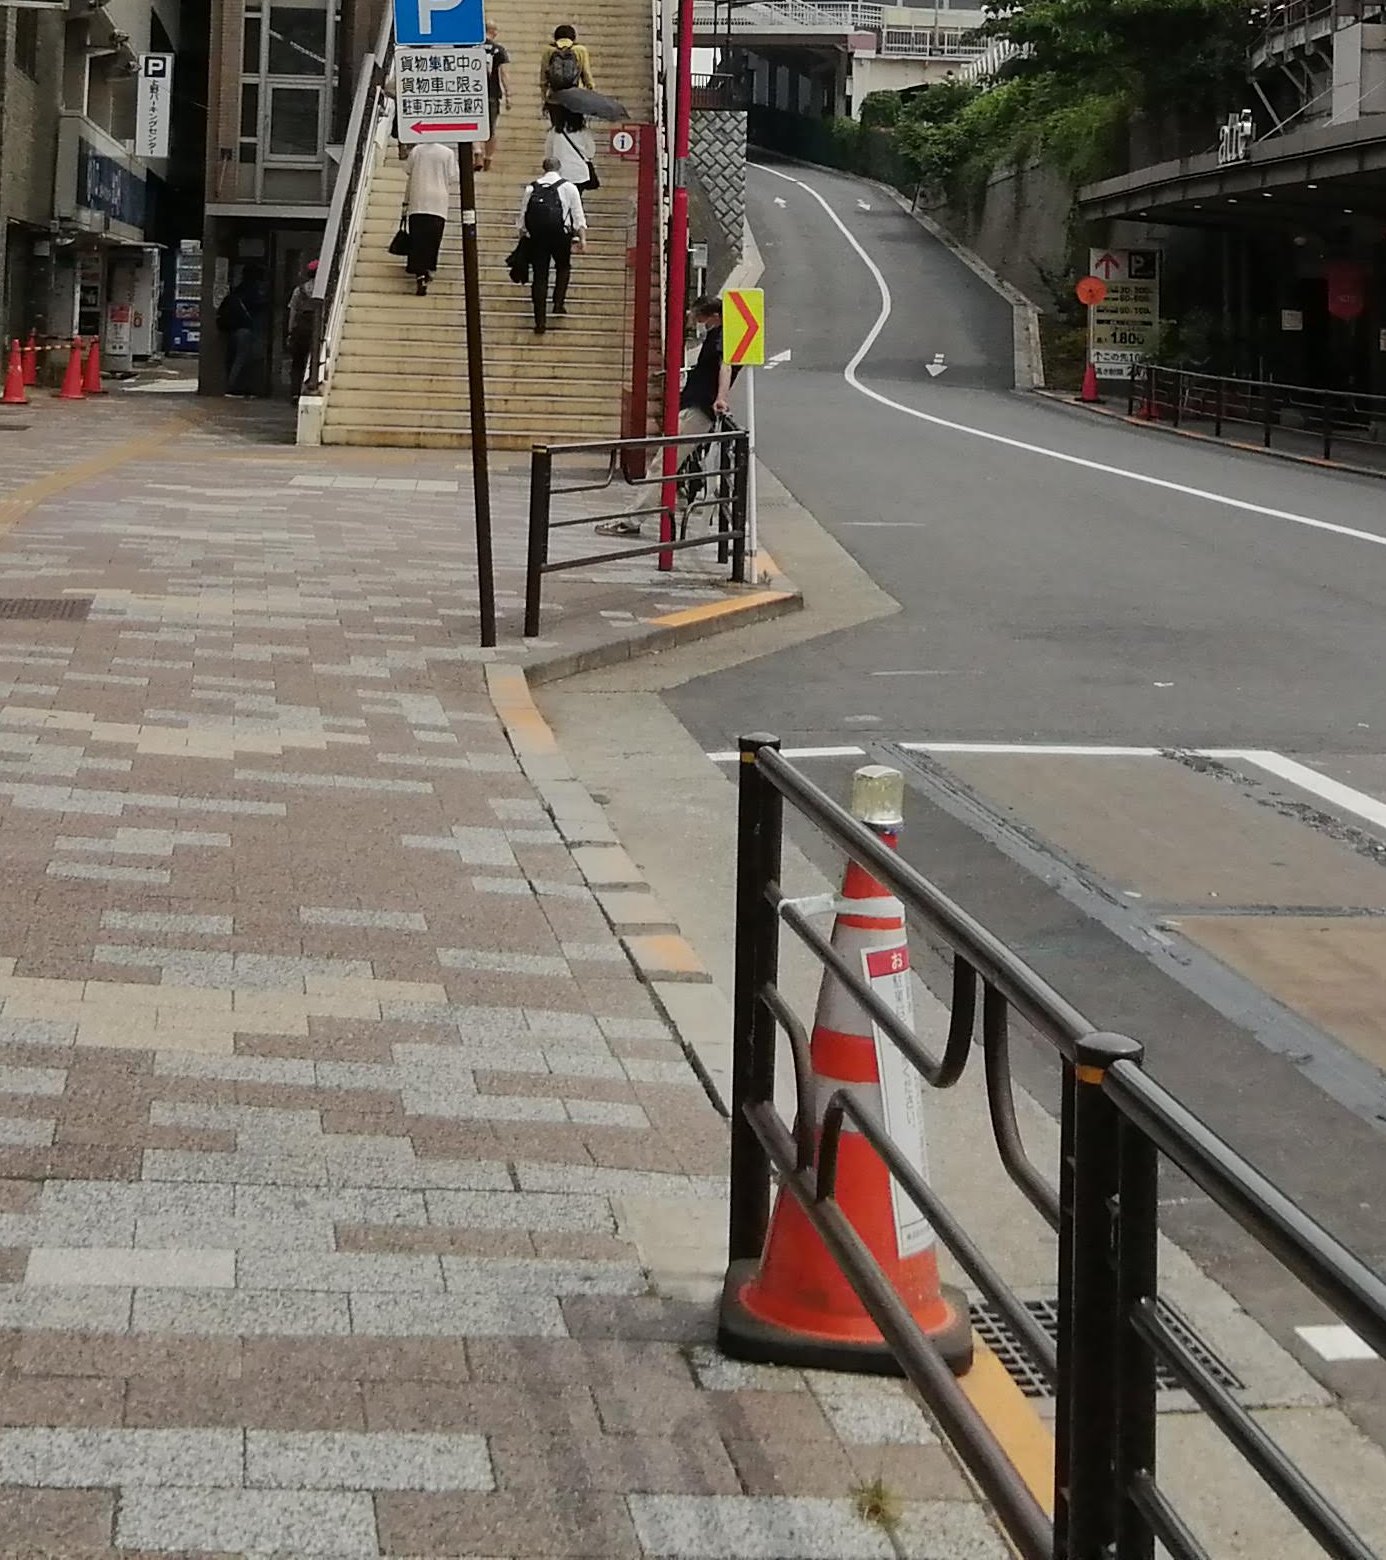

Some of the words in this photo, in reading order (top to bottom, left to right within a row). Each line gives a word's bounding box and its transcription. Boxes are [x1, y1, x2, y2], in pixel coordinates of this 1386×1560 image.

[147, 59, 164, 76] P
[400, 54, 483, 73] 貨物集配中の
[401, 75, 484, 95] 貨物車に限る
[401, 96, 485, 116] 駐車方法表示線内
